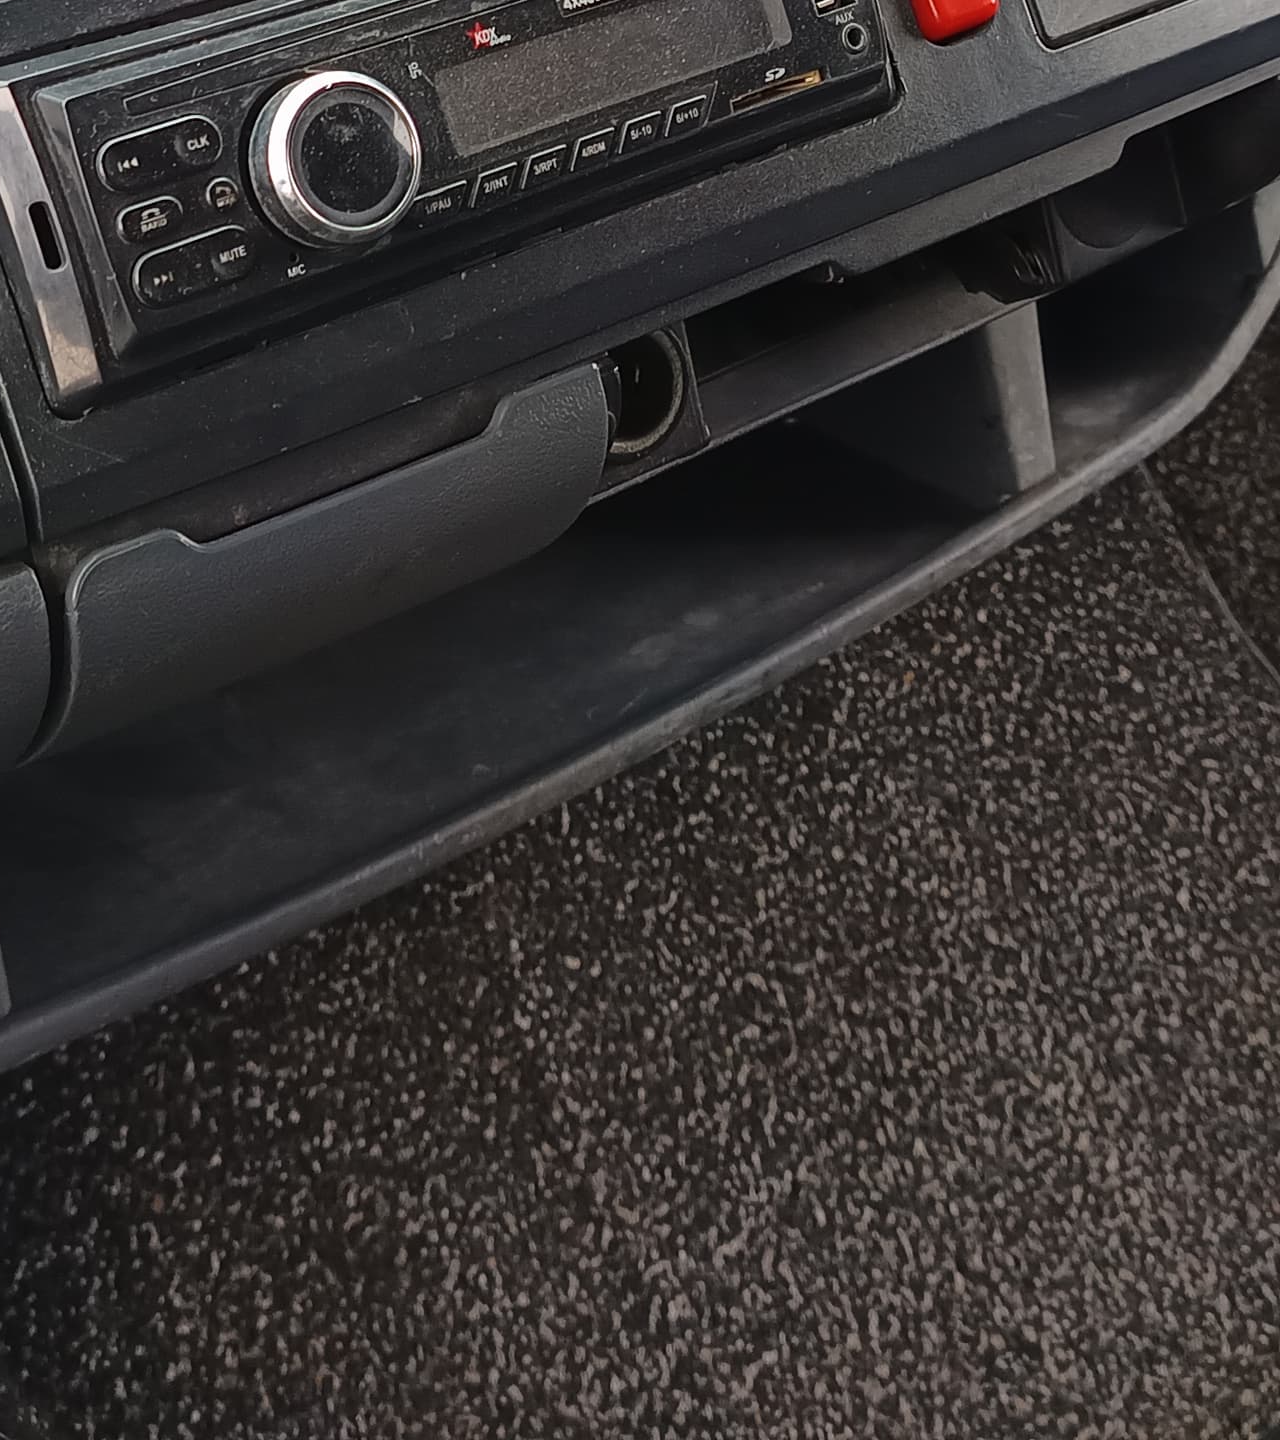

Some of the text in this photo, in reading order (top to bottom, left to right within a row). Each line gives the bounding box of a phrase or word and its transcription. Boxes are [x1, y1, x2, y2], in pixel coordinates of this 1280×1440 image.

[835, 11, 855, 26] AUX
[187, 134, 210, 151] CLK
[532, 158, 557, 176] 3/RPT
[483, 175, 509, 194] 2/INT
[424, 197, 452, 215] 1/PAU
[219, 244, 247, 264] MUTE
[287, 263, 307, 279] MIC
